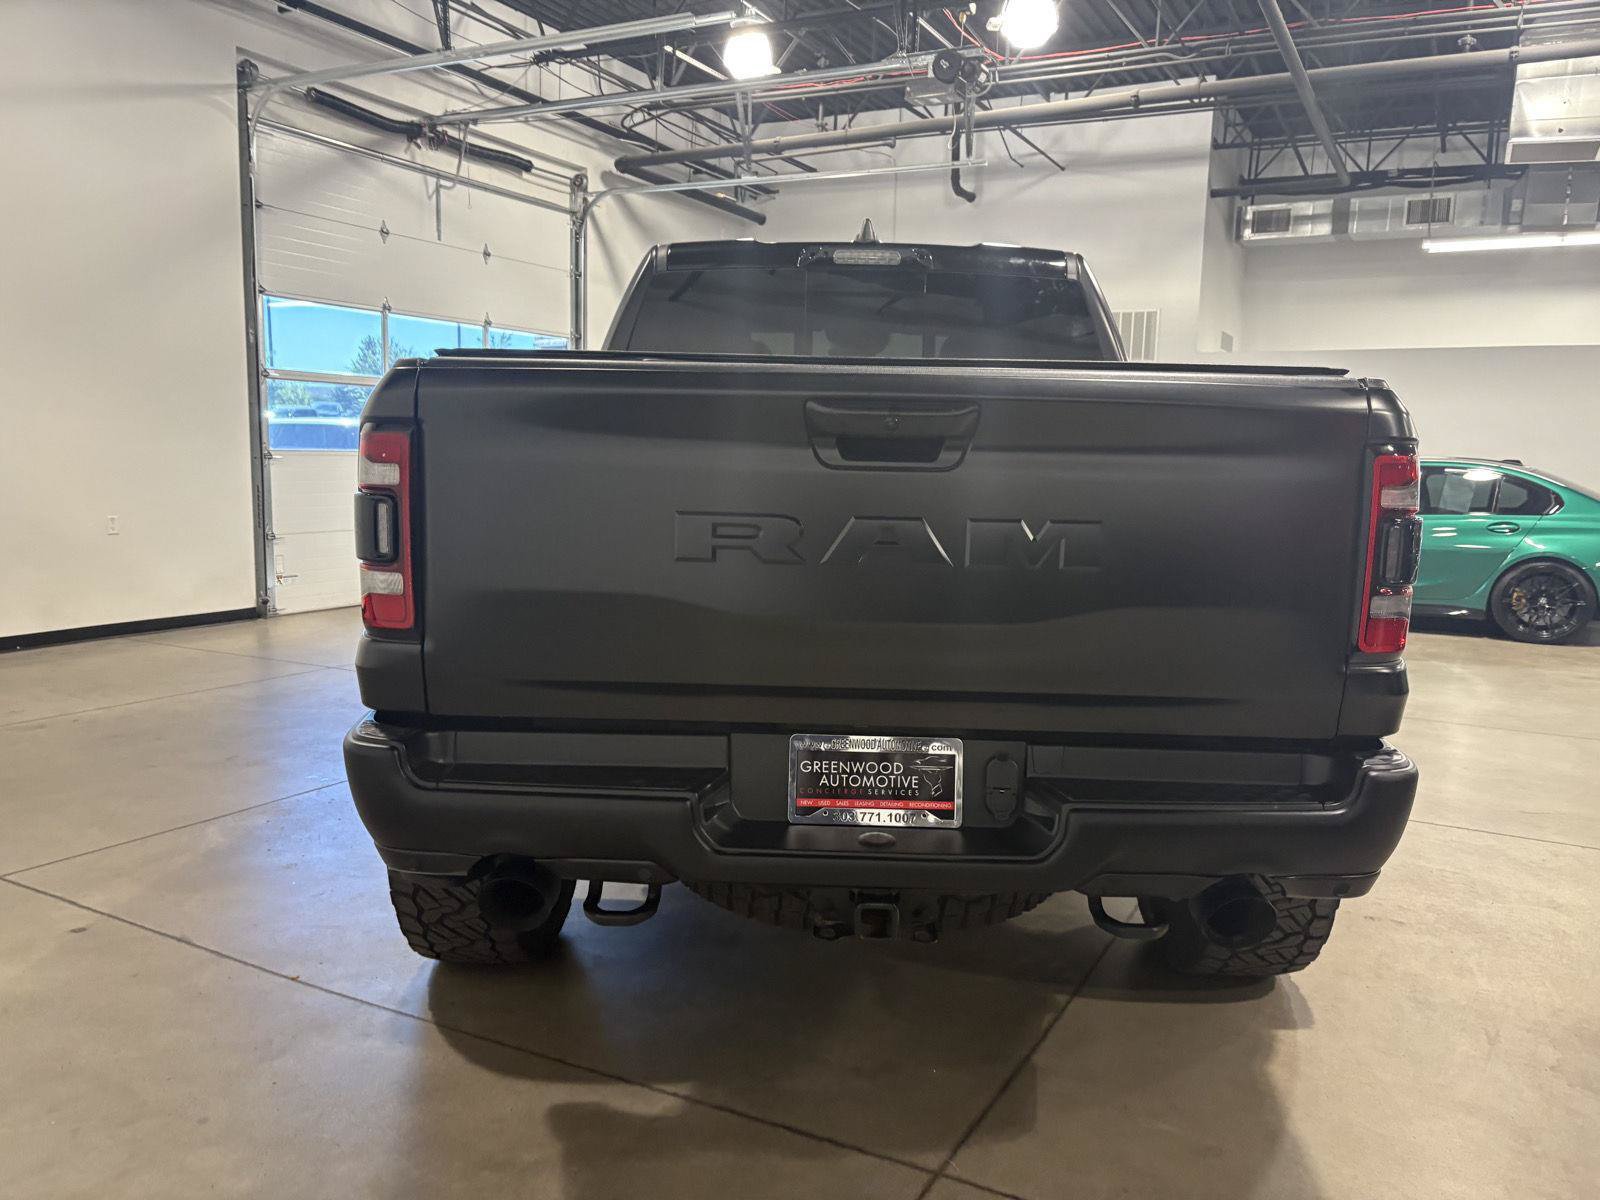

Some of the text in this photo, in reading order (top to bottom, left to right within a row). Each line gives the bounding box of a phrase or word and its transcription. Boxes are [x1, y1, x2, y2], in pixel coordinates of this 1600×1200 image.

[674, 511, 1104, 571] RAM
[800, 760, 904, 775] GREENWOOD
[819, 775, 919, 789] AUTOMOTIVE
[799, 787, 920, 797] CONCIERGE SERVICES
